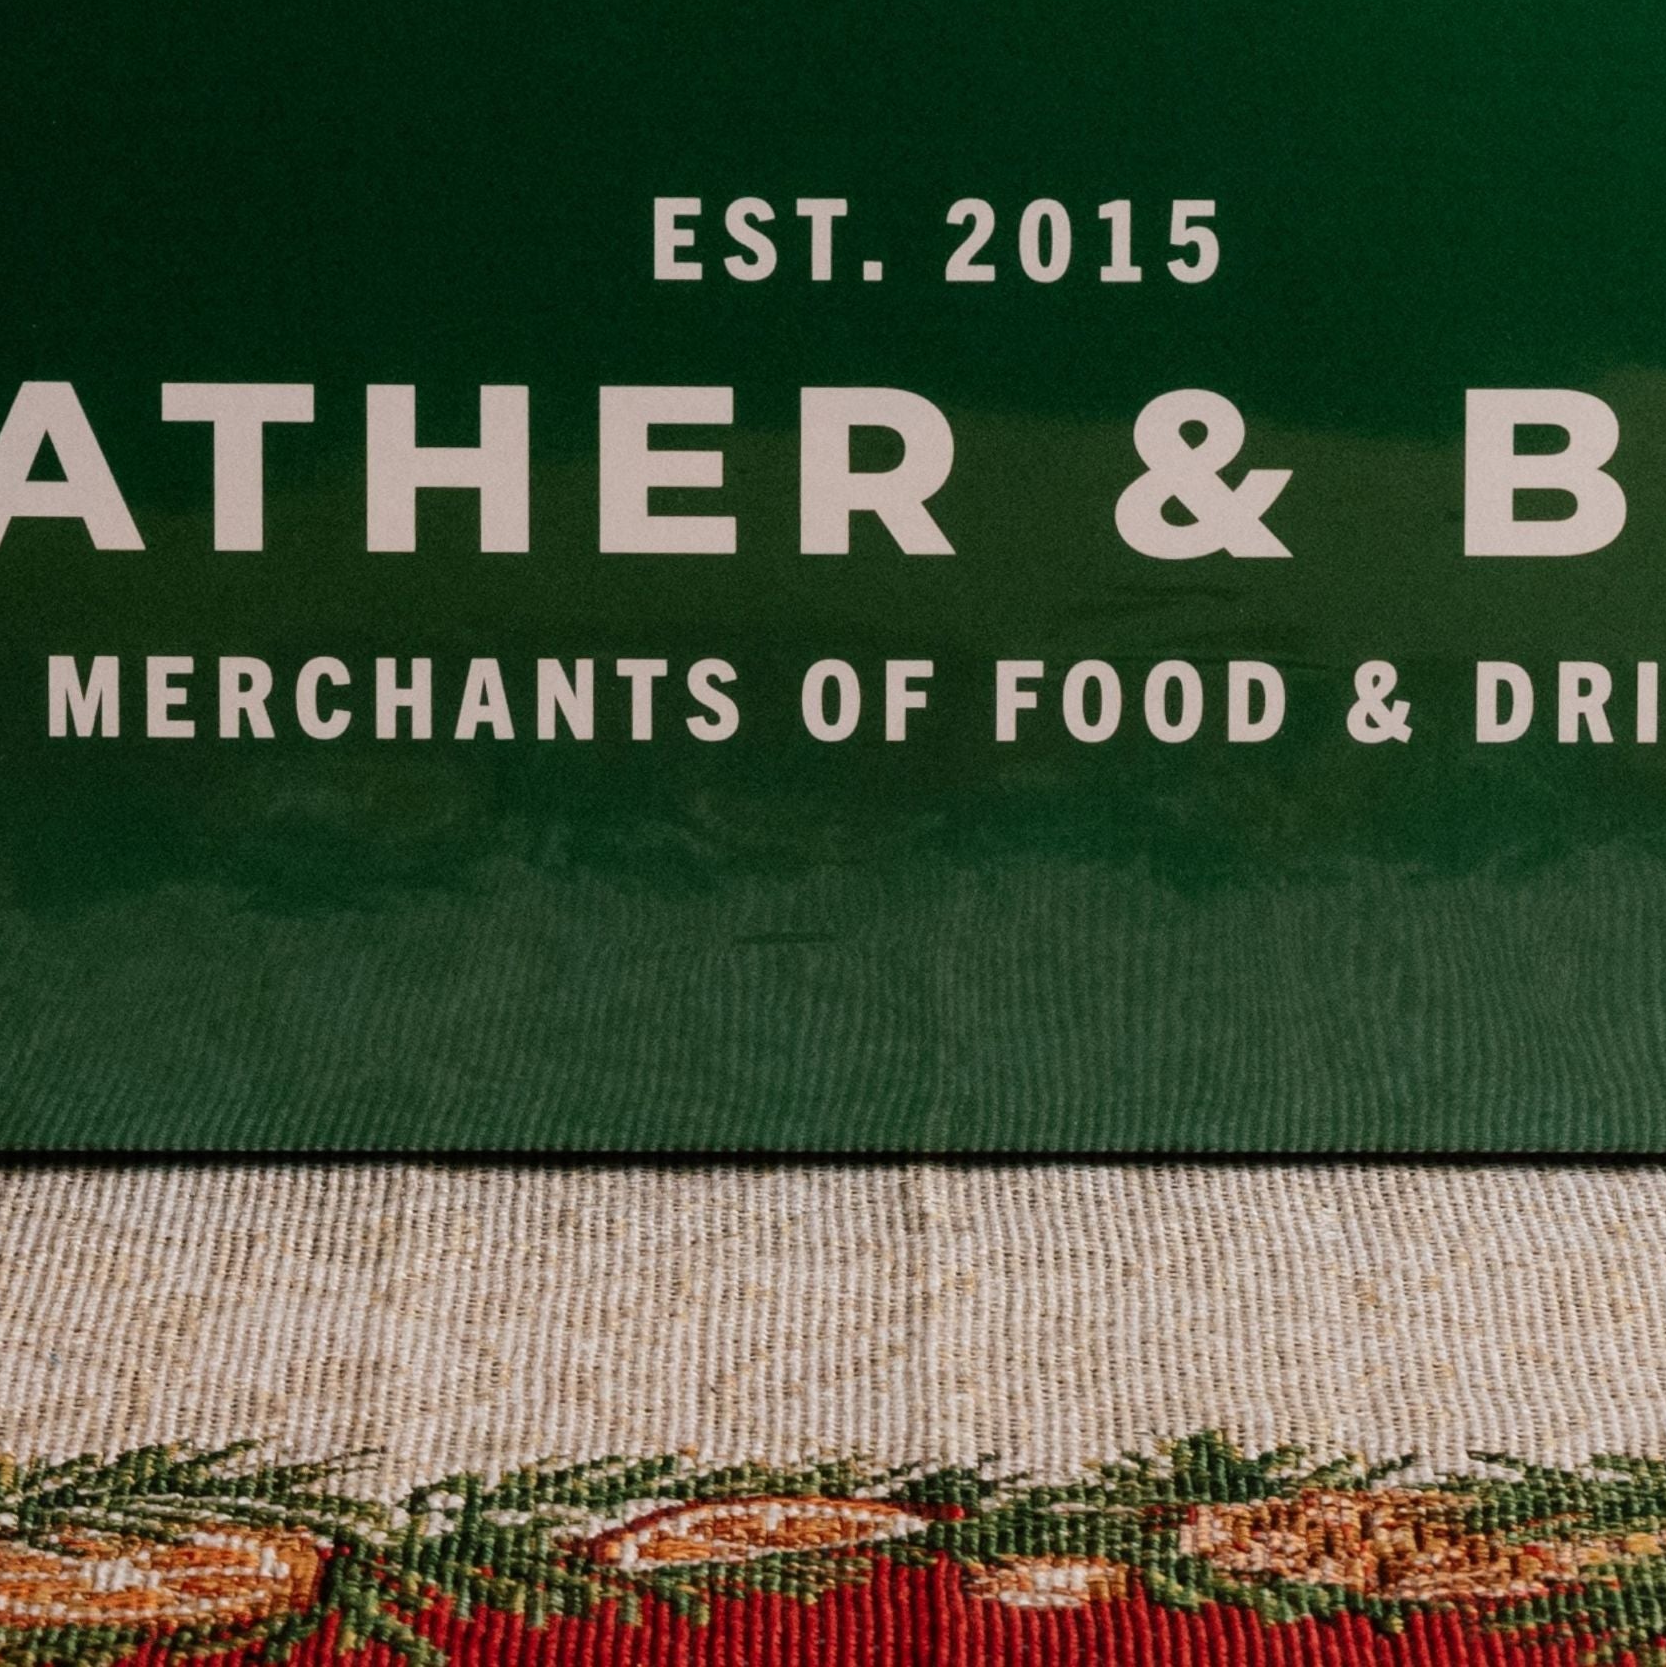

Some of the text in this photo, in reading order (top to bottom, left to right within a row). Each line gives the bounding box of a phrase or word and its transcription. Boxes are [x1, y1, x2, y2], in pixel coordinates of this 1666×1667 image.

[652, 195, 1224, 285] EST. 2015
[1113, 387, 1296, 561] &
[45, 653, 742, 745] MERCHANTS
[800, 657, 937, 744] OF
[994, 659, 1288, 745] FOOD
[1345, 659, 1413, 745] &
